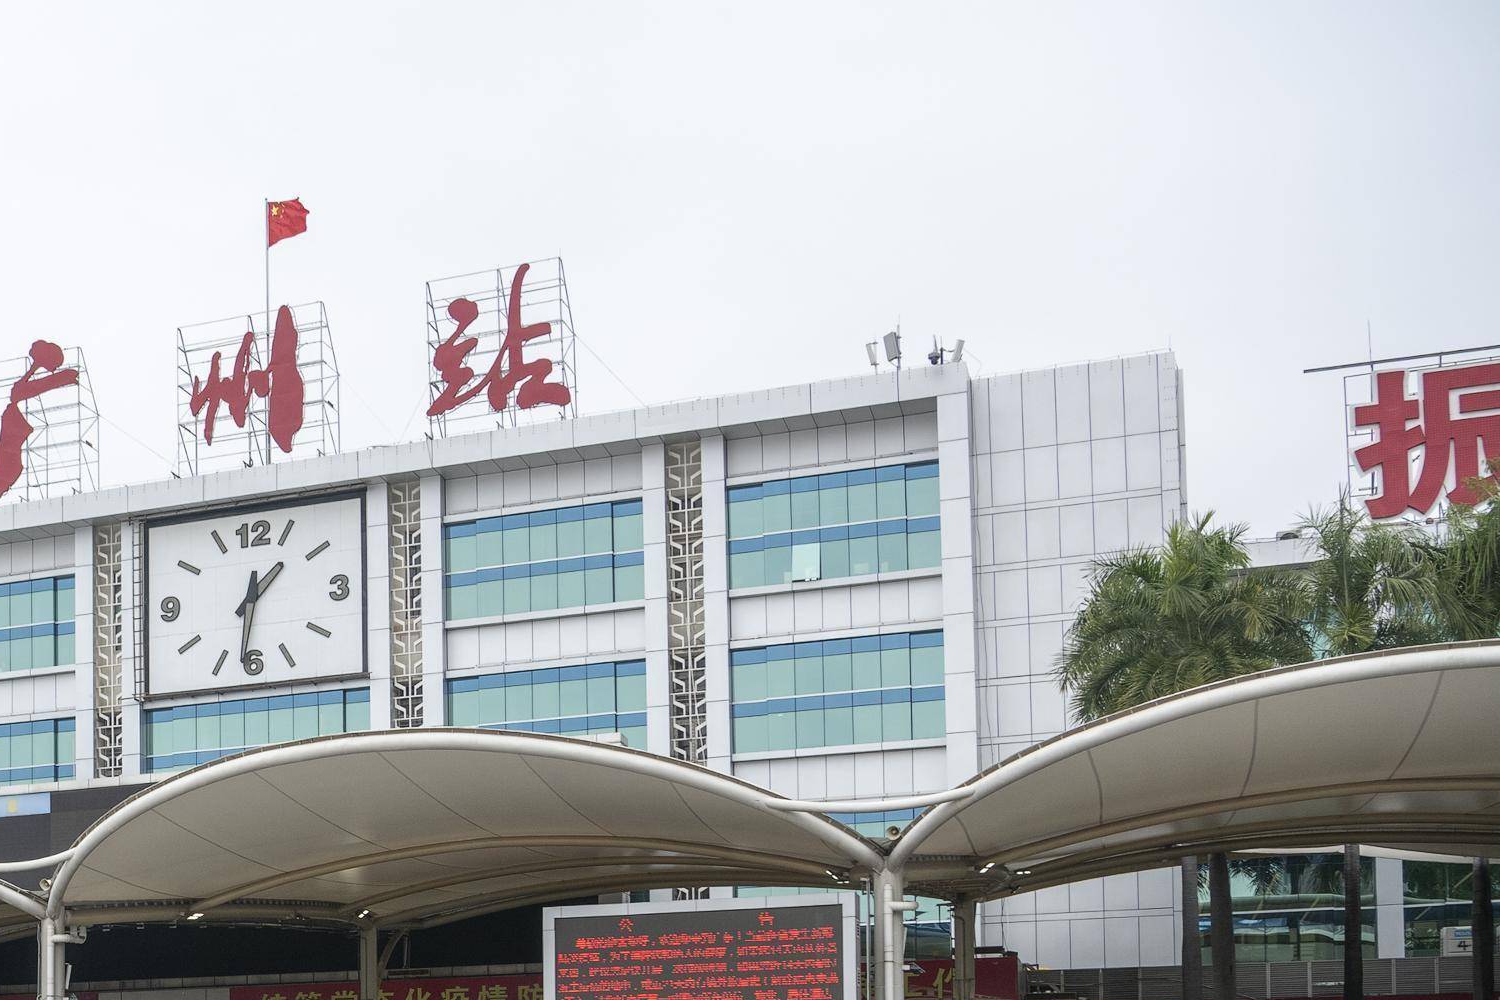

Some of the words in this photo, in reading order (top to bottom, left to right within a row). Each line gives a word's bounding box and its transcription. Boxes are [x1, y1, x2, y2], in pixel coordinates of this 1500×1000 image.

[235, 519, 271, 549] 12
[328, 575, 350, 601] 3
[160, 597, 181, 622] 9
[243, 650, 264, 676] 6
